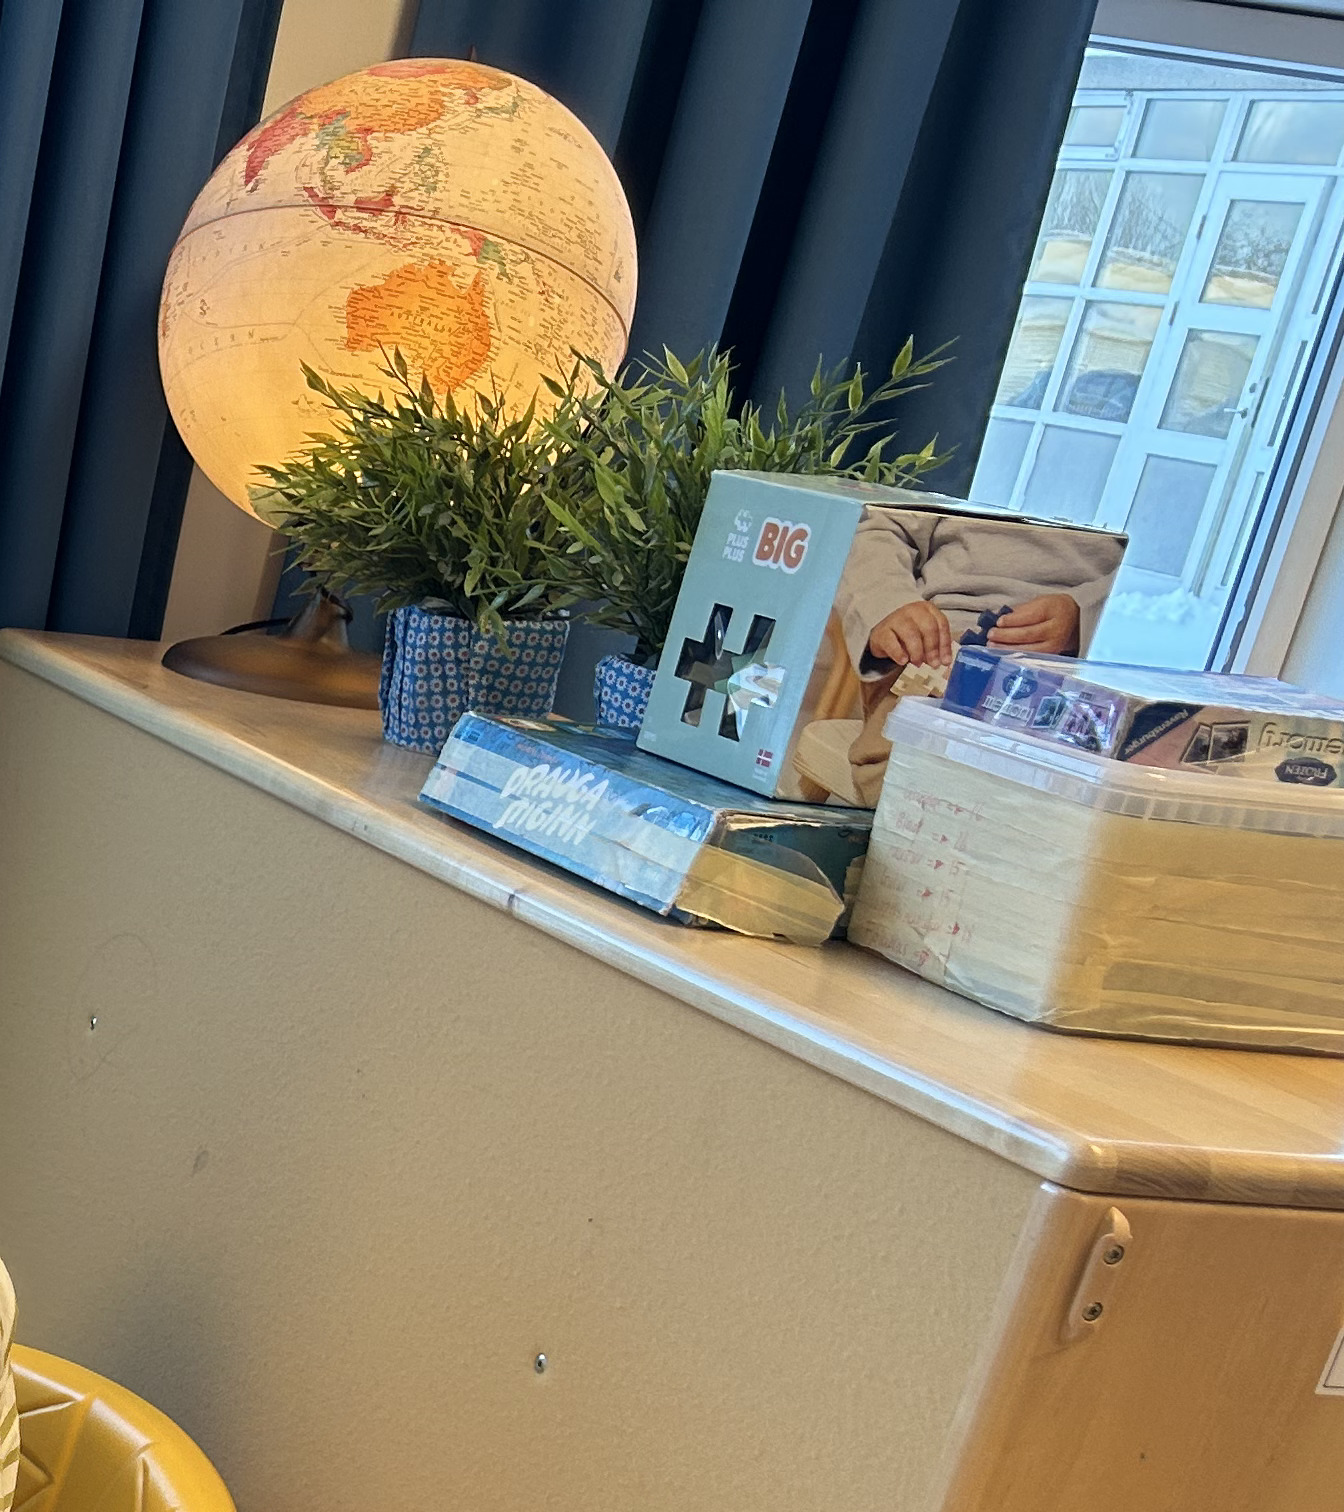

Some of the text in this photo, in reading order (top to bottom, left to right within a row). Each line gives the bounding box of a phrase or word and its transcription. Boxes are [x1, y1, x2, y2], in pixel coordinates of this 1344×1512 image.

[726, 532, 750, 549] PLUS
[753, 519, 810, 571] BIG
[721, 545, 745, 562] PLUS
[1258, 721, 1344, 755] emory
